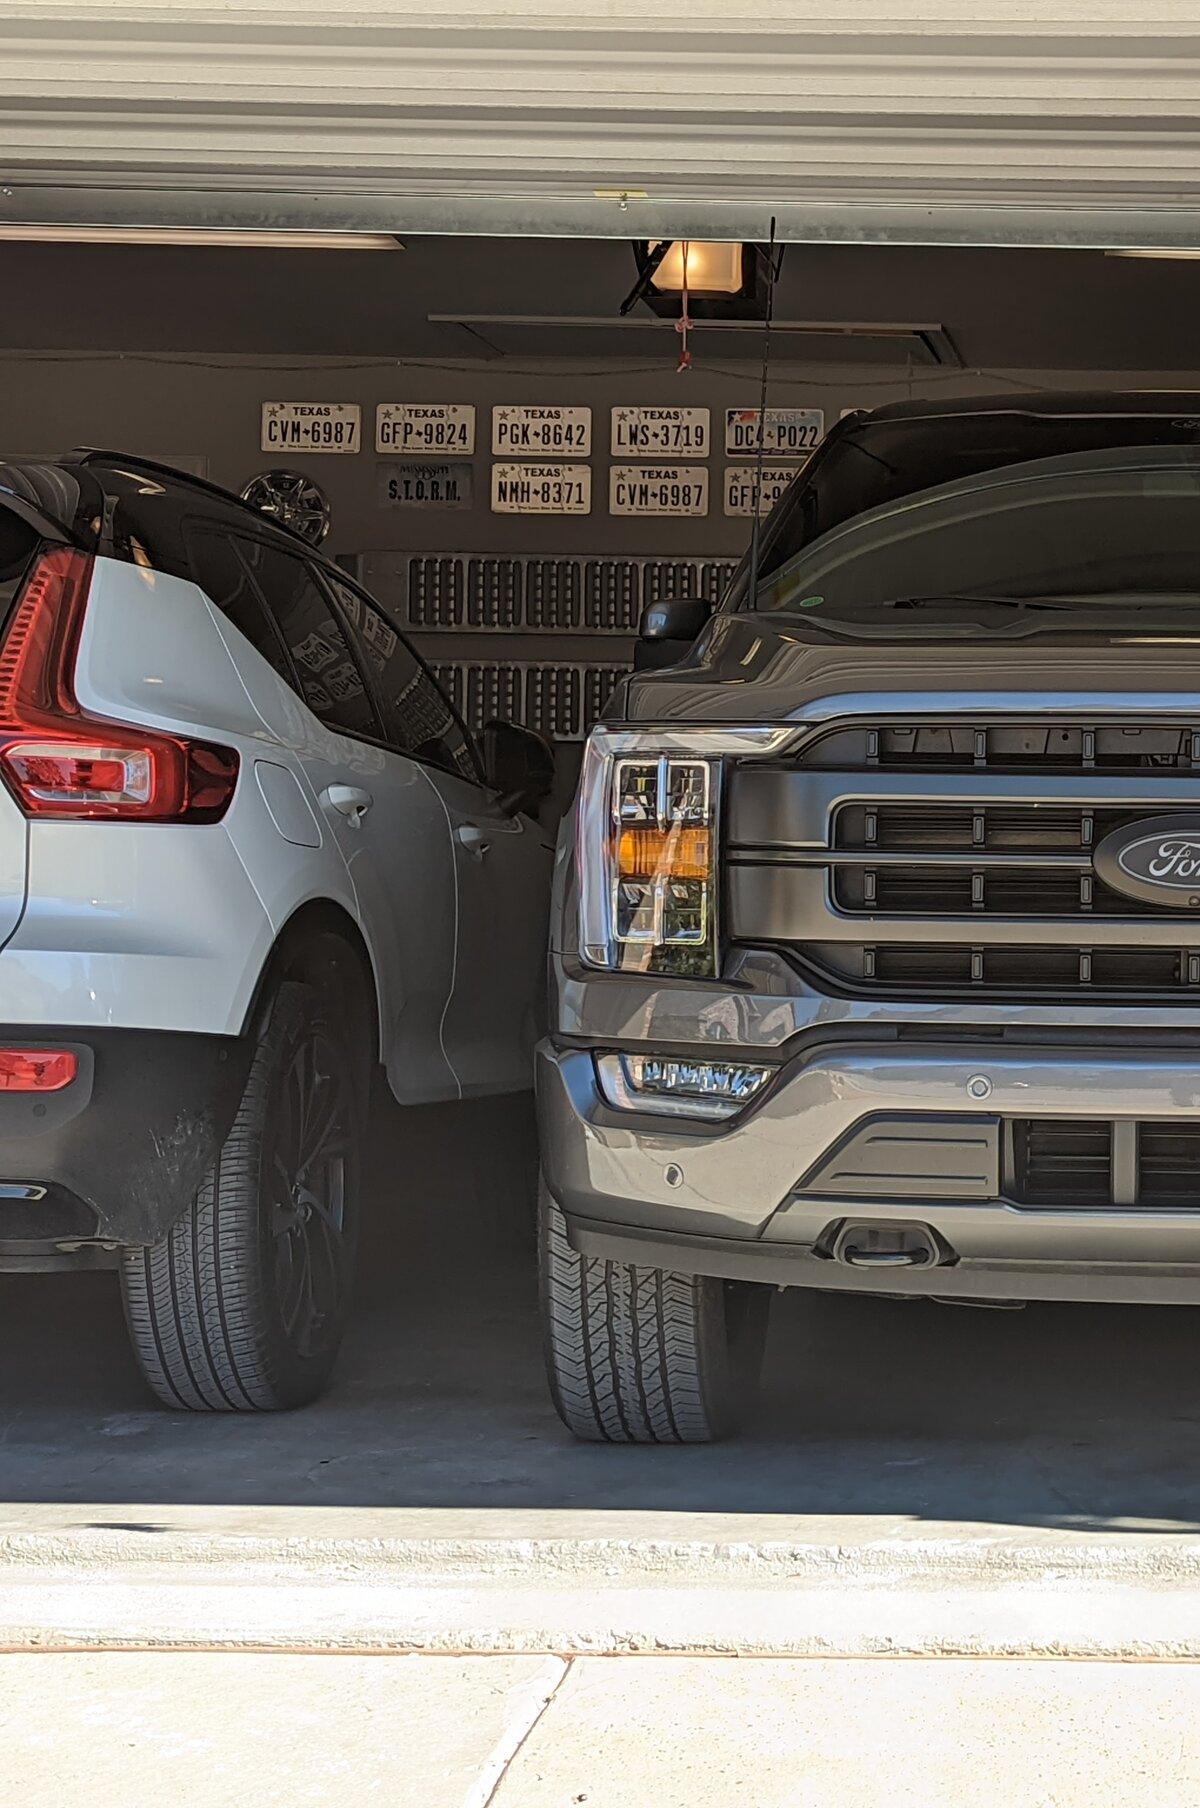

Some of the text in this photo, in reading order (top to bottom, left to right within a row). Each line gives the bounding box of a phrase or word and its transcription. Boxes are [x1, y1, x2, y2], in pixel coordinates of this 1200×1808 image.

[292, 406, 331, 416] TEXAS
[406, 408, 445, 418] TEXAS
[523, 409, 561, 419] TEXAS
[642, 410, 680, 420] TEXAS
[523, 467, 561, 477] TEXAS
[640, 470, 678, 480] TEXAS
[388, 479, 461, 501] S.T.O.R.M.
